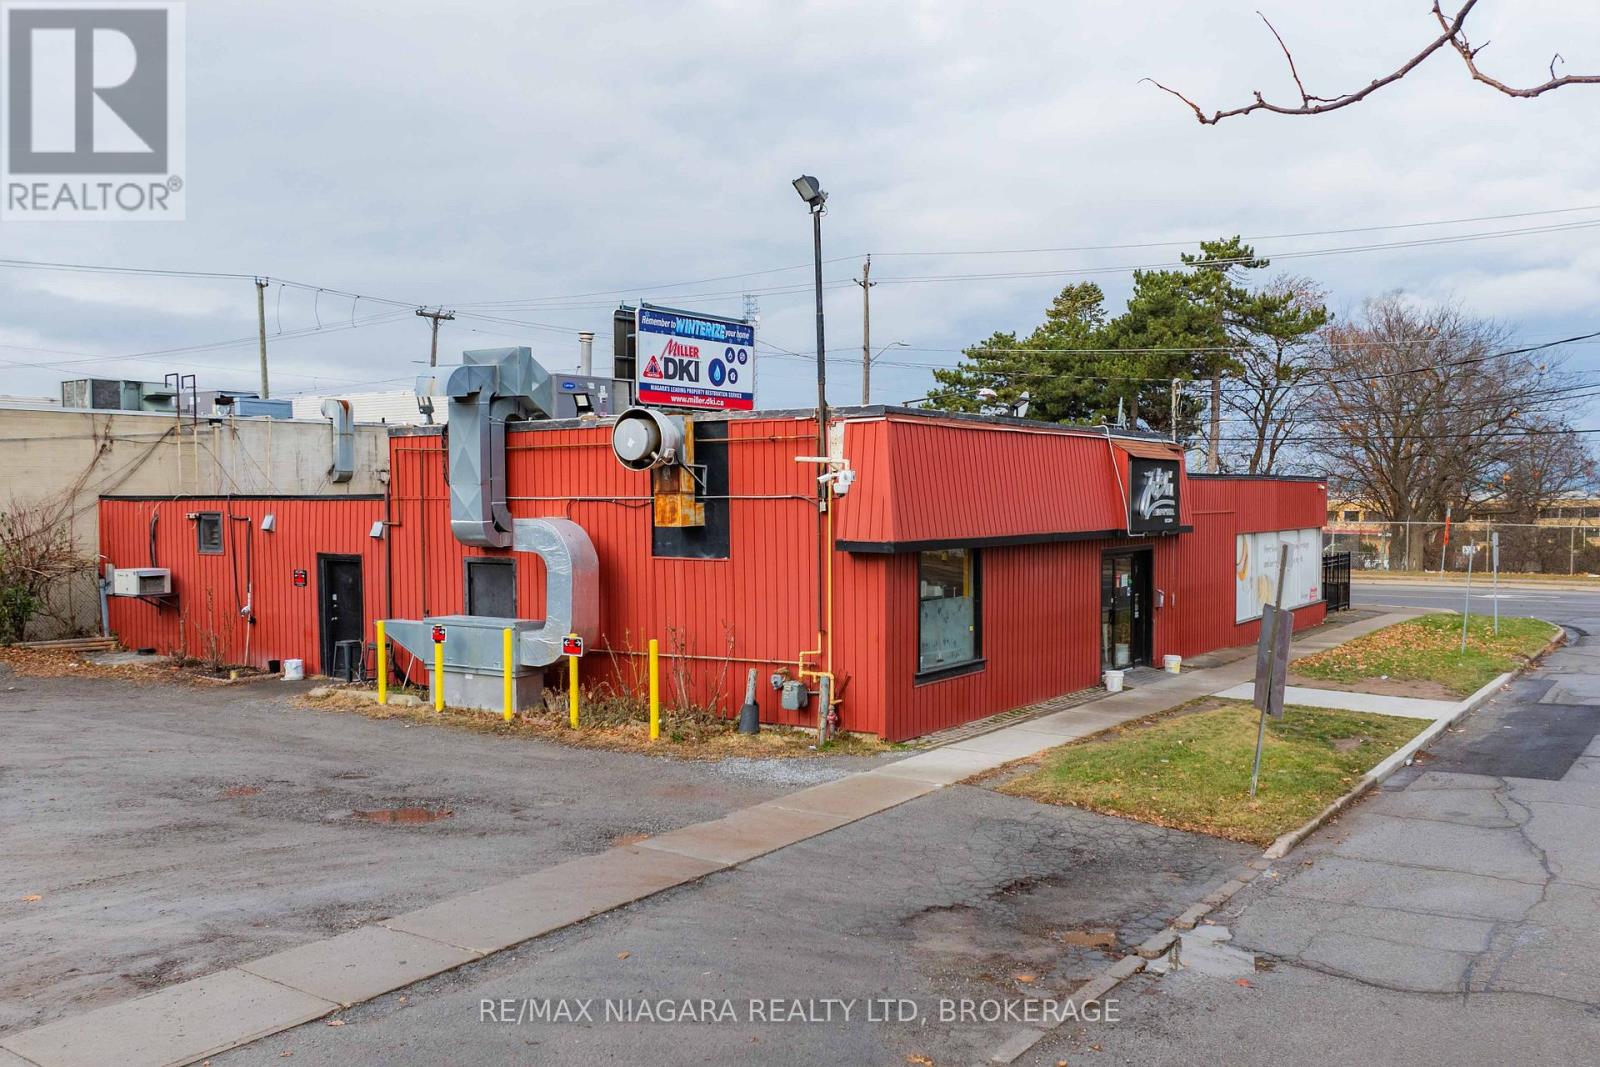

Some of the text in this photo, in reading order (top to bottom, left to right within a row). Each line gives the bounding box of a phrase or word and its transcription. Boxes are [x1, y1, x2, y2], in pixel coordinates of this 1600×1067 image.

[641, 315, 749, 339] Remember to WINTERIZE your home
[661, 338, 700, 359] MILLER
[664, 357, 700, 382] DKI
[671, 395, 725, 406] www.miller.dki.ca
